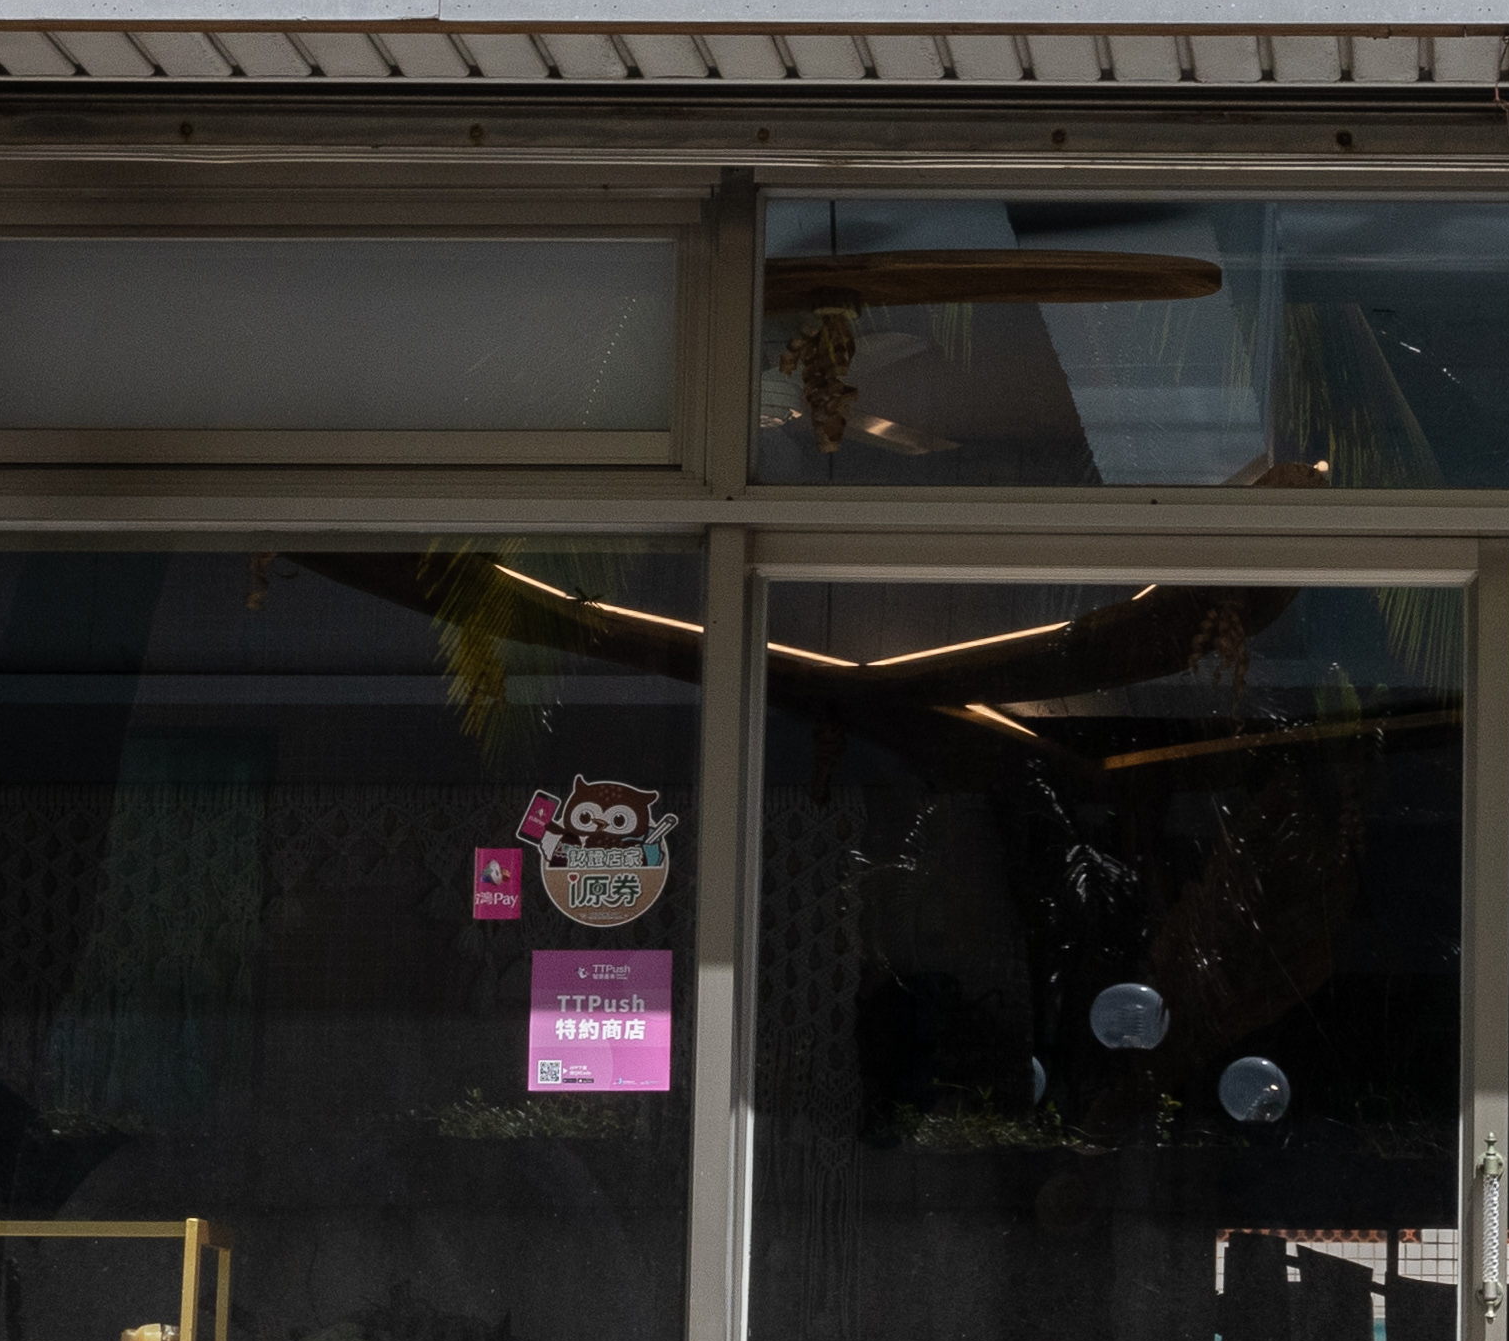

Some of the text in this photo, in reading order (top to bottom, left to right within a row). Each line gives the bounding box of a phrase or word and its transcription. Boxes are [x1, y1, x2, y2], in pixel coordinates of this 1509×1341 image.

[592, 964, 631, 974] TTPush
[557, 994, 645, 1013] TTPush
[555, 1019, 646, 1040] 特約商店
